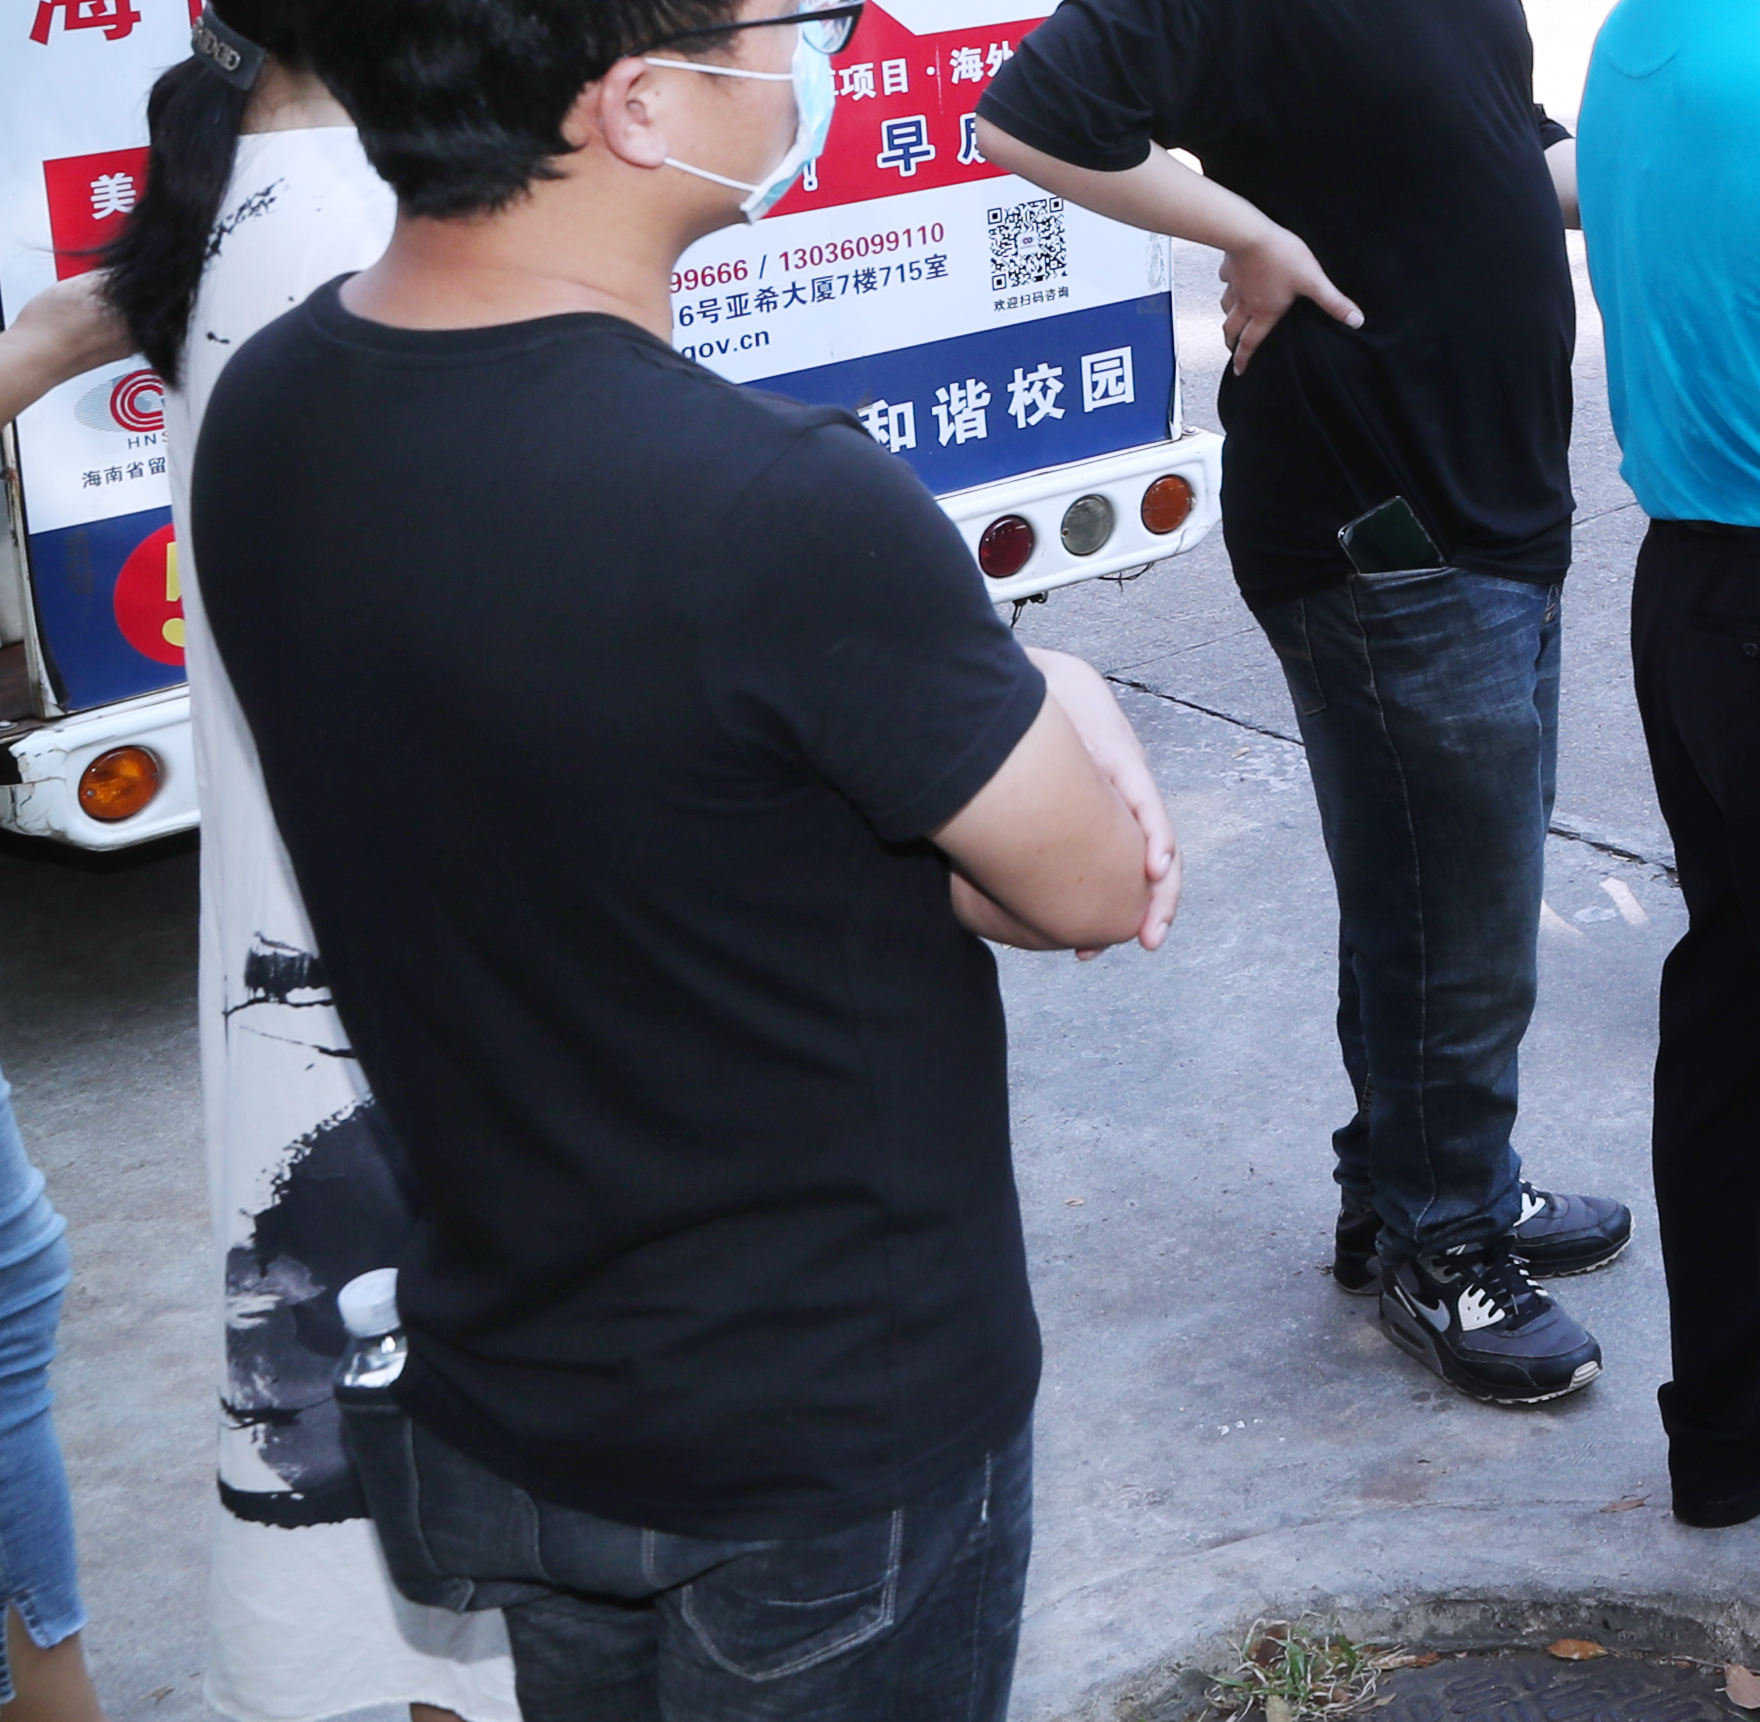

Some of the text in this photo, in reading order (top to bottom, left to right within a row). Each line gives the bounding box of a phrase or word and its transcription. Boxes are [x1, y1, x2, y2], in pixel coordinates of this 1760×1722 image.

[778, 221, 946, 273] 13036099110
[993, 287, 1070, 313] 欢迎扫码咨询
[857, 345, 1136, 454] 和谐校园
